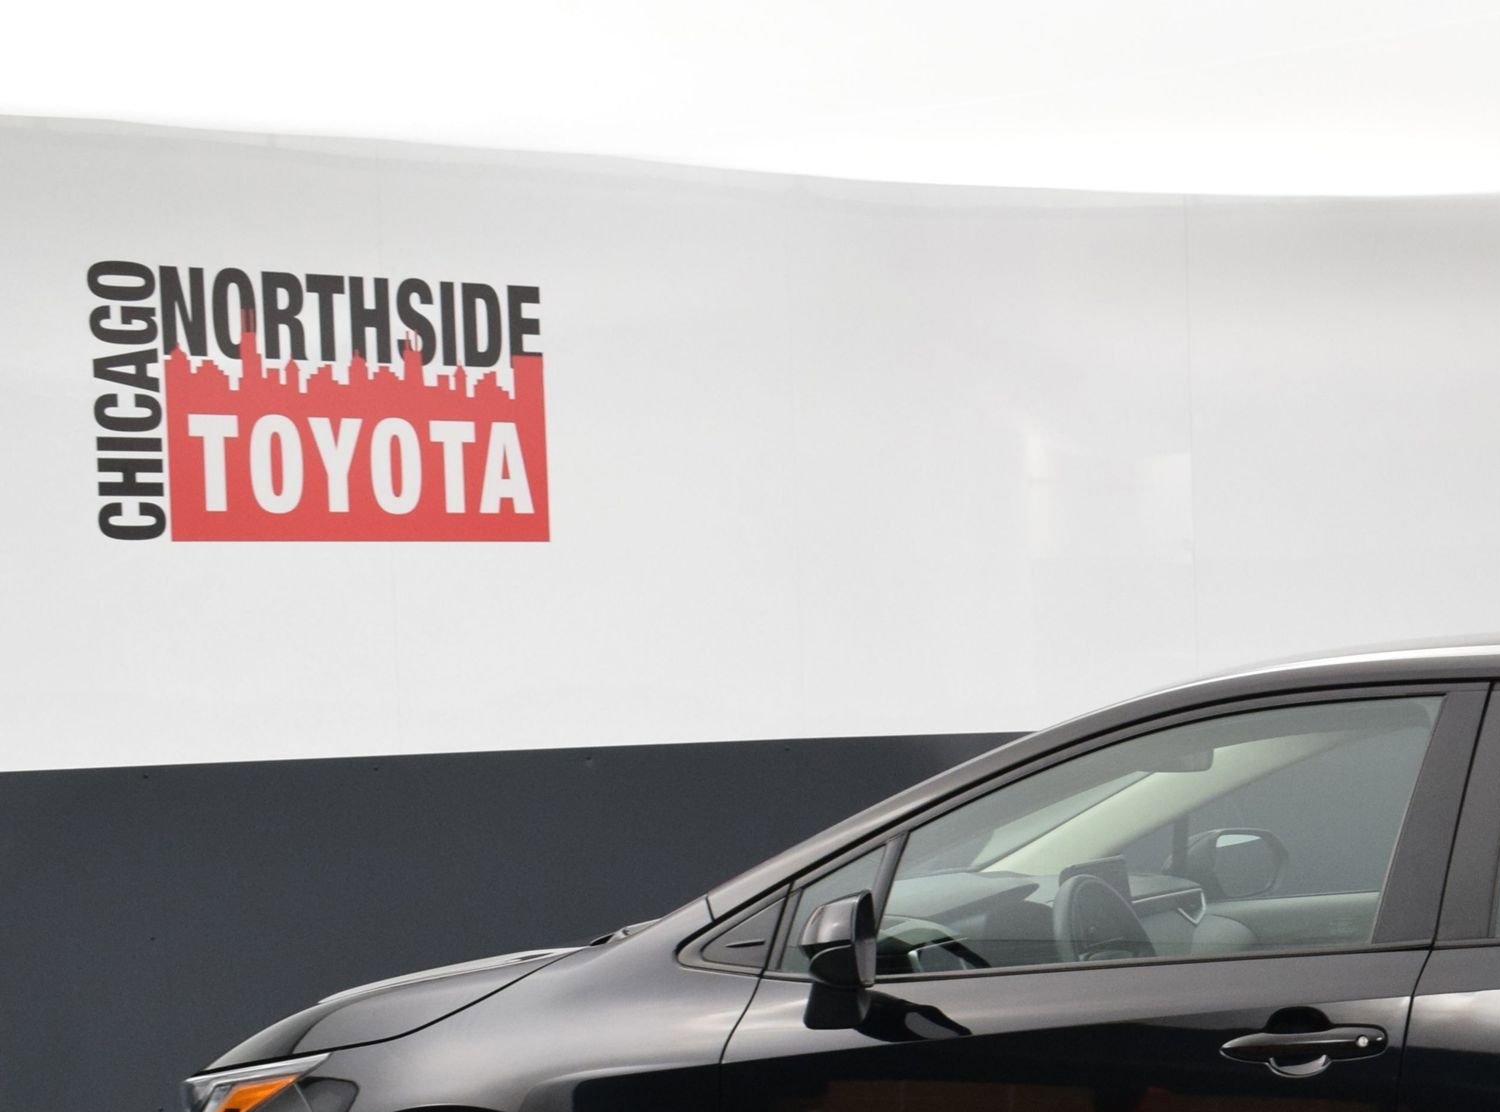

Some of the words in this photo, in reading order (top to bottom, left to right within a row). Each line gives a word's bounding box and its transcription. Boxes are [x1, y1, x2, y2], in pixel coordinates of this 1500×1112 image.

[158, 264, 543, 368] NORTHSIDE
[87, 260, 166, 541] CHICAGO
[187, 413, 535, 515] TOYOTA
